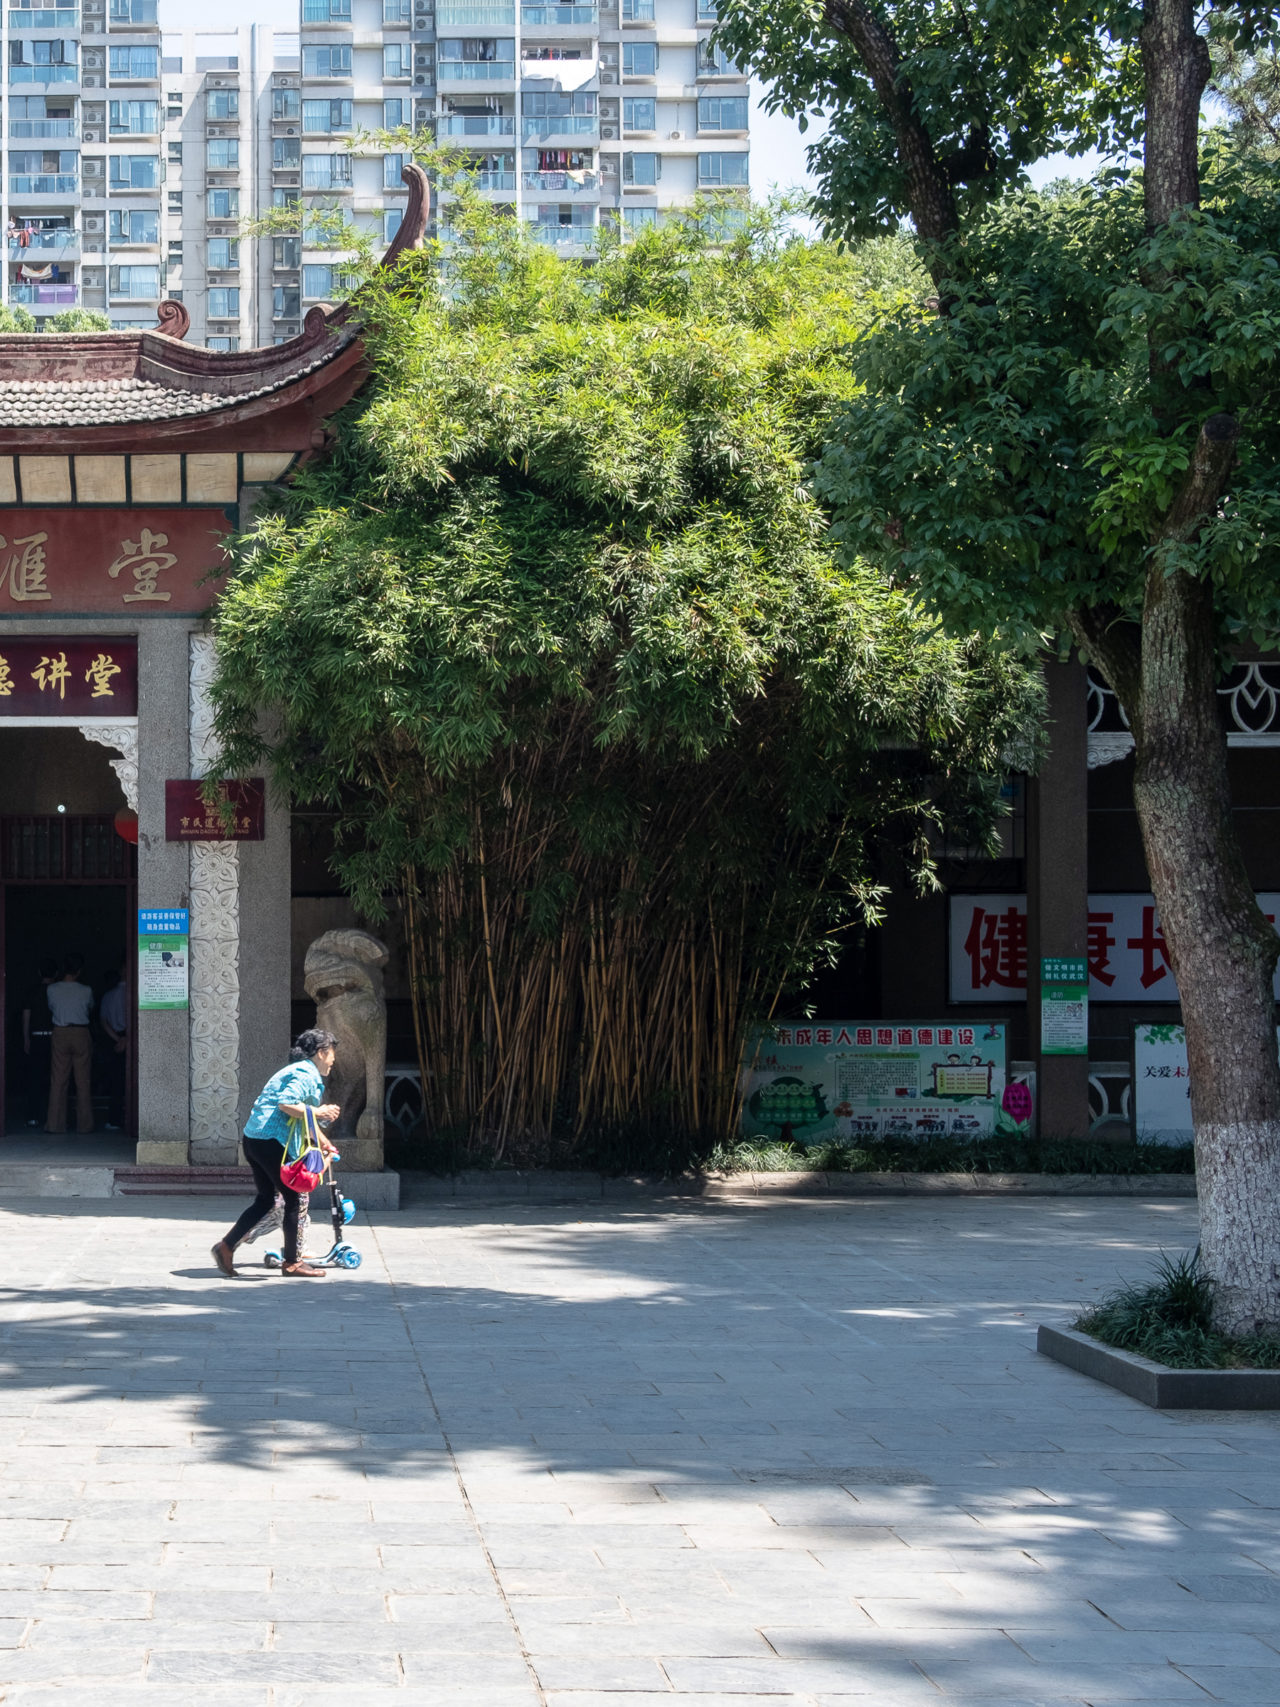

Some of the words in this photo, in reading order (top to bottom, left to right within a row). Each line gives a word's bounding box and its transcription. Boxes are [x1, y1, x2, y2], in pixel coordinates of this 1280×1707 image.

[776, 1028, 976, 1047] 未成年人思想道德建设
[1144, 1066, 1190, 1079] 关爱未
